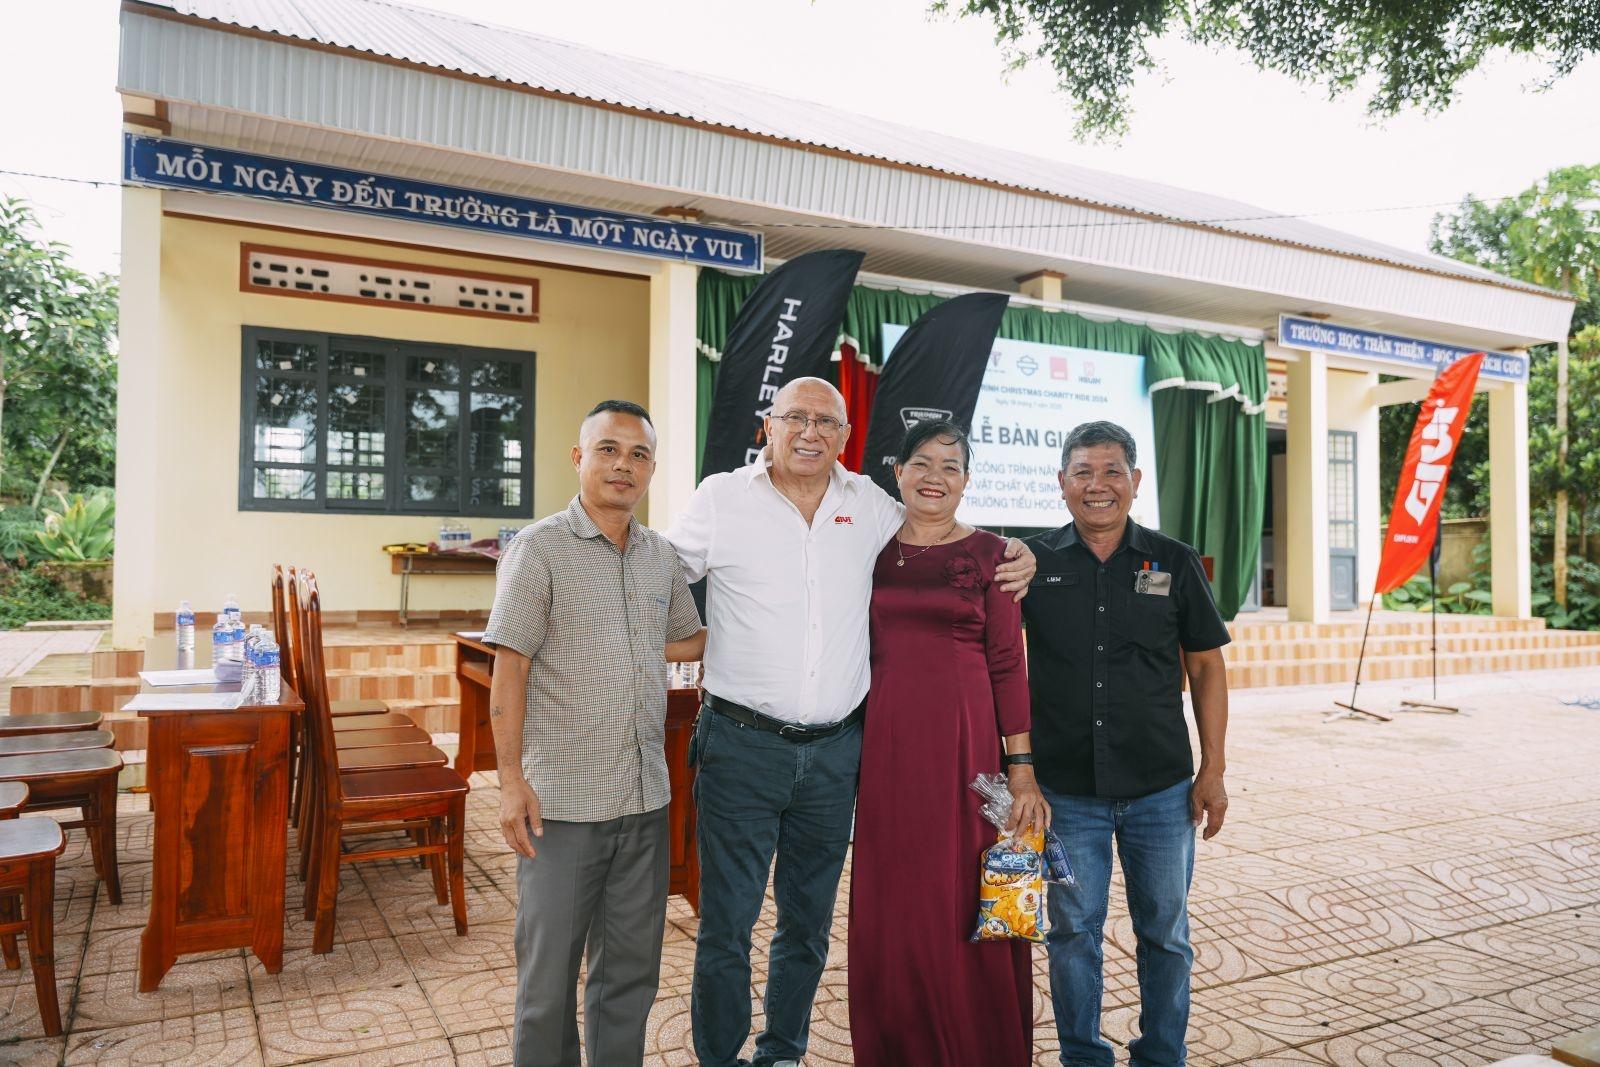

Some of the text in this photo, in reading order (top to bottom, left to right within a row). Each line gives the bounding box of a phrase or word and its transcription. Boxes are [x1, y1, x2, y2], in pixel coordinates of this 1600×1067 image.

[156, 147, 743, 261] MỖI NGÀY ĐẾN TRƯỜNG LÀ MỘT NGÀY VUI
[1290, 323, 1336, 346] TRƯỜNG
[1338, 334, 1361, 351] HỌC
[1363, 336, 1393, 353] THÂN
[1394, 341, 1424, 361] THIỆN
[1432, 348, 1453, 364] HỌC
[1503, 359, 1523, 376] CỰC
[1000, 386, 1042, 397] CHRISTMAS
[1044, 389, 1073, 399] CHARITY
[970, 416, 1063, 449] LỄ BÀN GI
[882, 456, 897, 465] FO
[975, 461, 1057, 476] CÔNG TRÌNH NÂN
[995, 479, 1020, 491] CHẤT
[1039, 483, 1060, 494] SINH
[966, 496, 1008, 509] TRƯỜNG
[1010, 495, 1033, 509] TIỂU
[1034, 500, 1056, 511] HỌC
